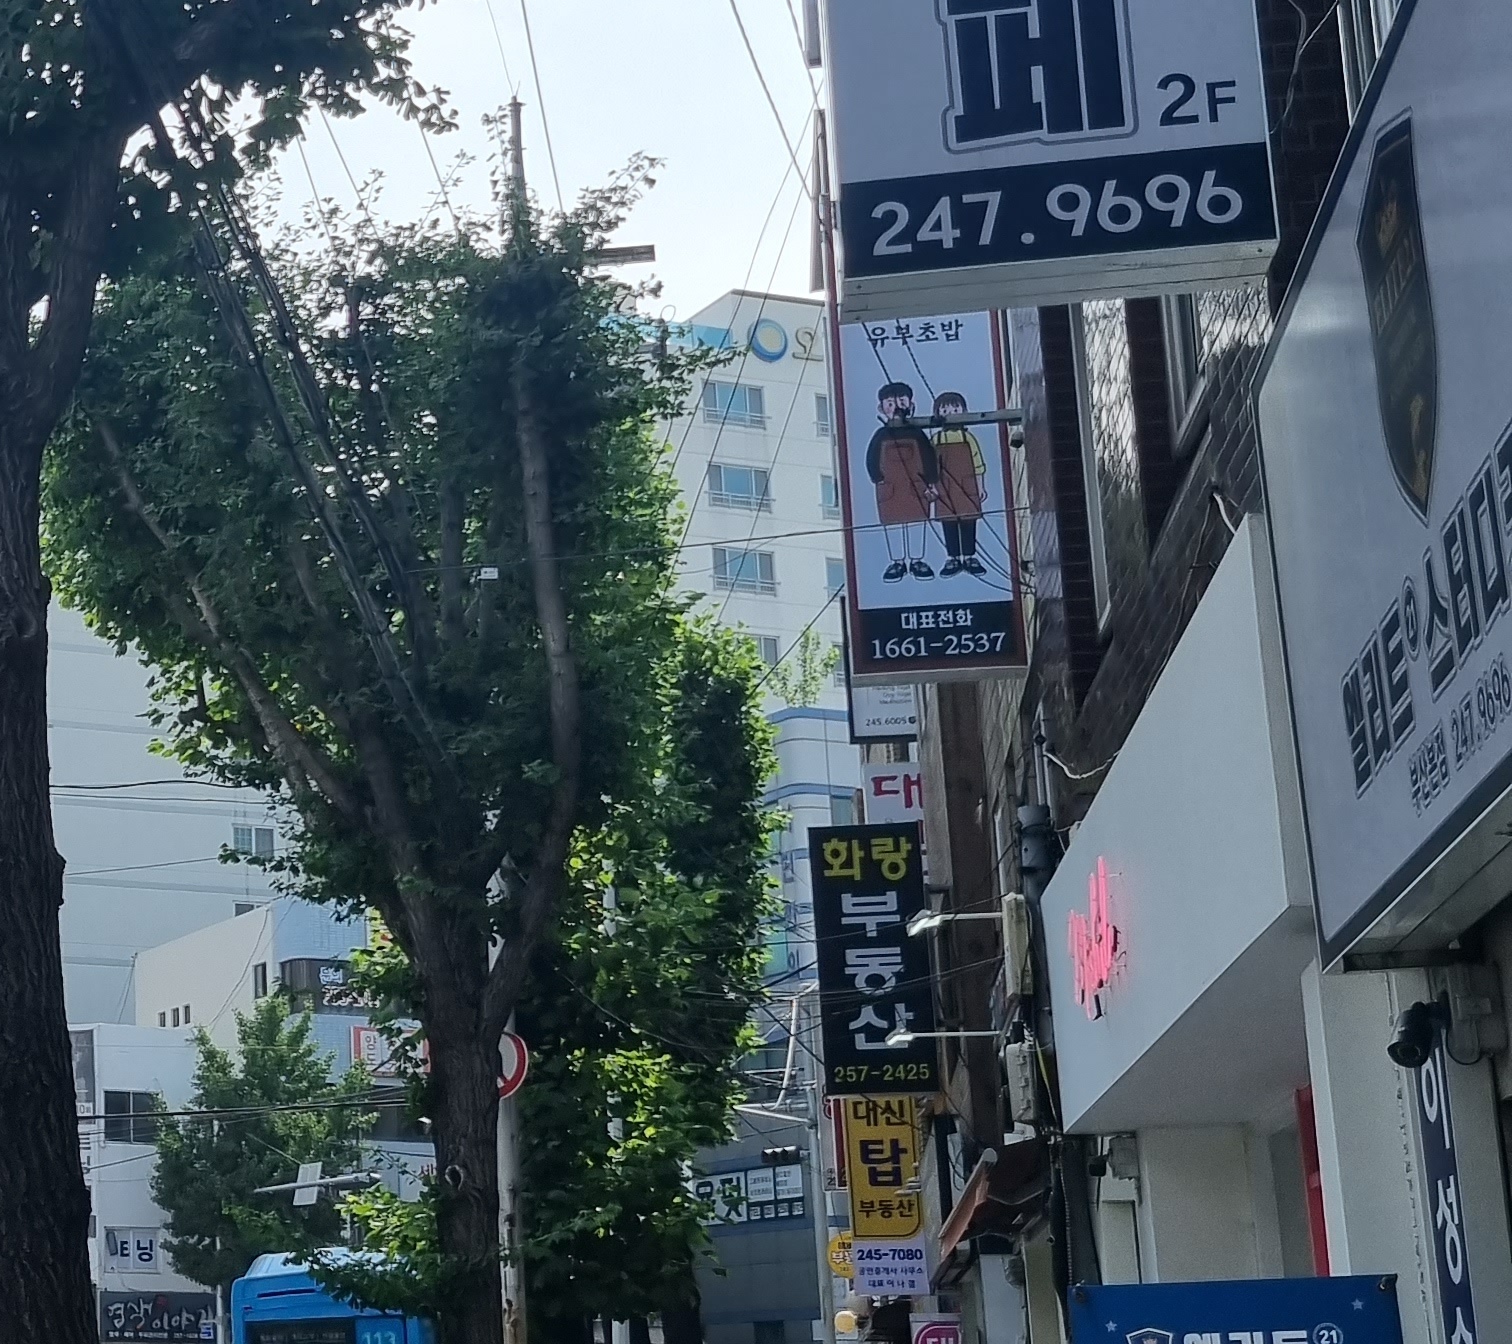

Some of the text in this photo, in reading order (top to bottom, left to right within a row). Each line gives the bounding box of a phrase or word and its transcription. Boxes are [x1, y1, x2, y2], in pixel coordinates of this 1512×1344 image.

[1156, 70, 1238, 128] 2F
[869, 167, 1244, 258] 247.9696
[867, 317, 964, 348] 유부초밥
[900, 608, 974, 631] 대표전화
[871, 631, 1006, 660] 1661-2537
[1342, 597, 1416, 798] 엘리트
[822, 836, 912, 881] 화랑
[841, 892, 914, 1051] 부동산
[834, 1064, 930, 1084] 257-2425
[852, 1099, 907, 1127] 대신
[859, 1138, 908, 1187] 탑
[858, 1199, 916, 1219] 부동산
[857, 1248, 924, 1261] 245-7080
[1318, 1330, 1338, 1344] 21
